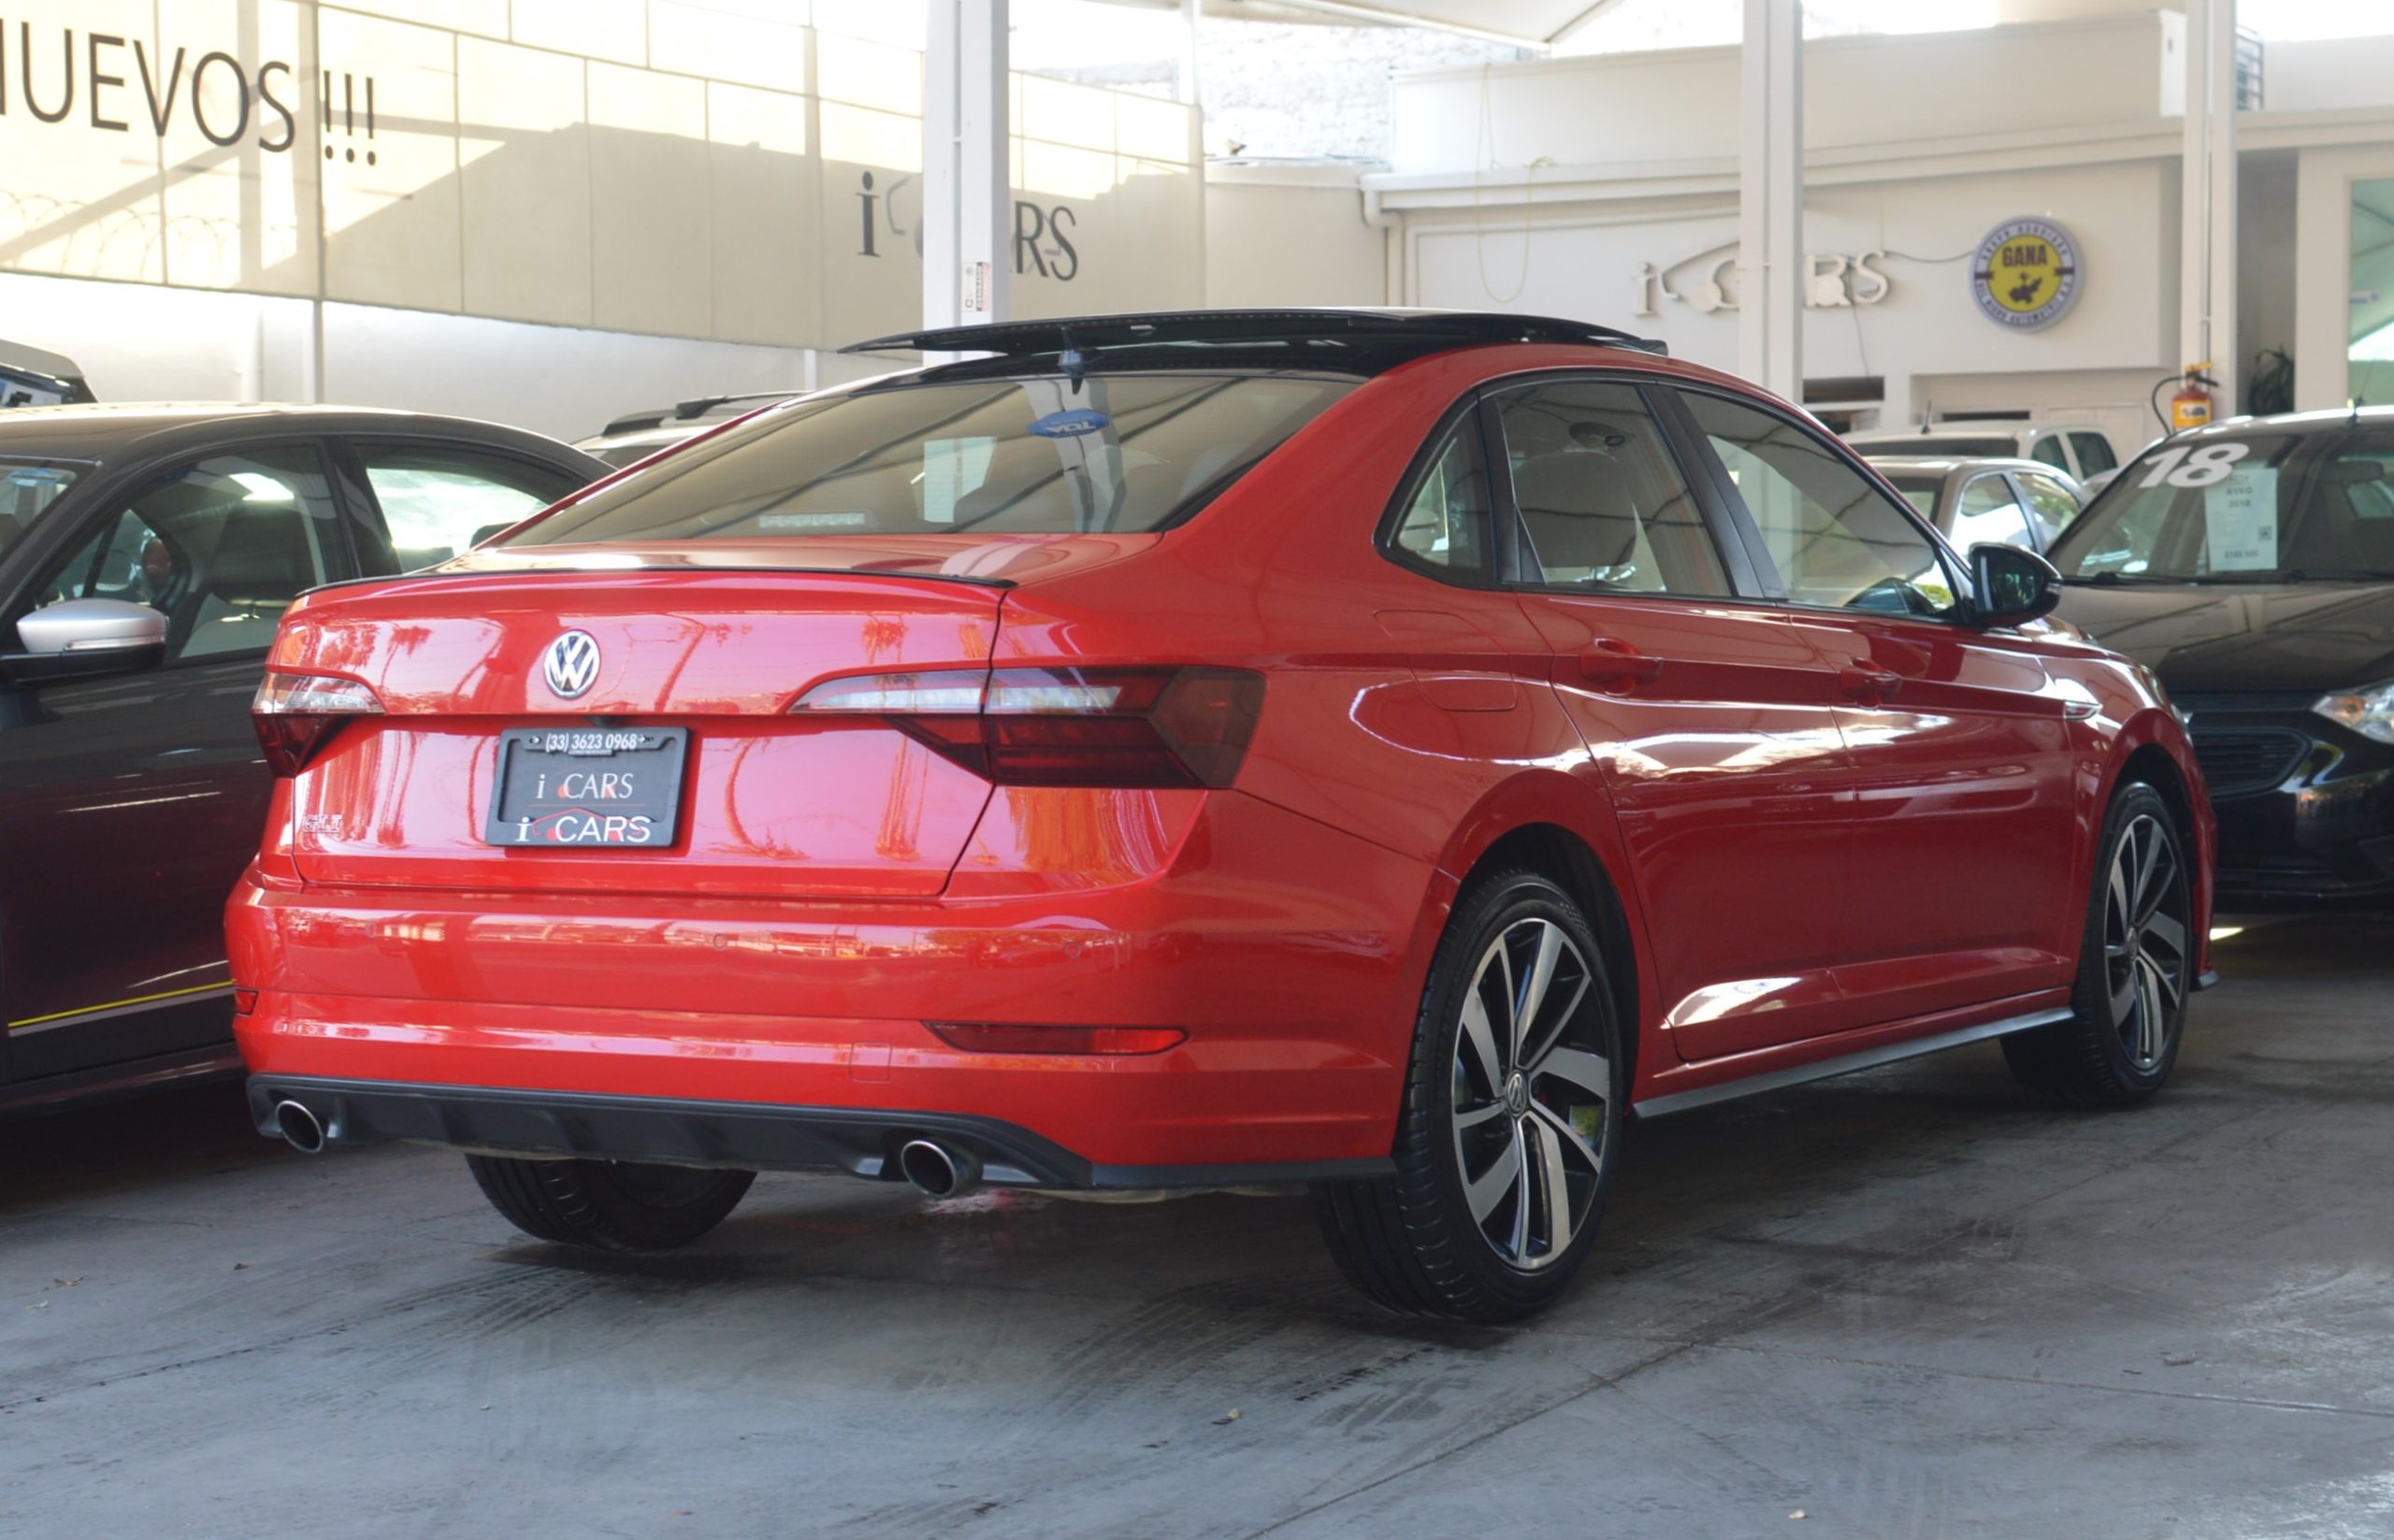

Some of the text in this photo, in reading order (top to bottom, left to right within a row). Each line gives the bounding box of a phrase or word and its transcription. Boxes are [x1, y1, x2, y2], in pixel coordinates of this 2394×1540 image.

[0, 19, 296, 154] UEVOS
[856, 170, 881, 257] i
[2002, 245, 2047, 267] GANA
[1633, 251, 1889, 315] i CRS
[2138, 442, 2250, 489] 18
[545, 733, 637, 754] (33) 3623 0968
[563, 772, 634, 799] CARS
[555, 815, 651, 843] CARS
